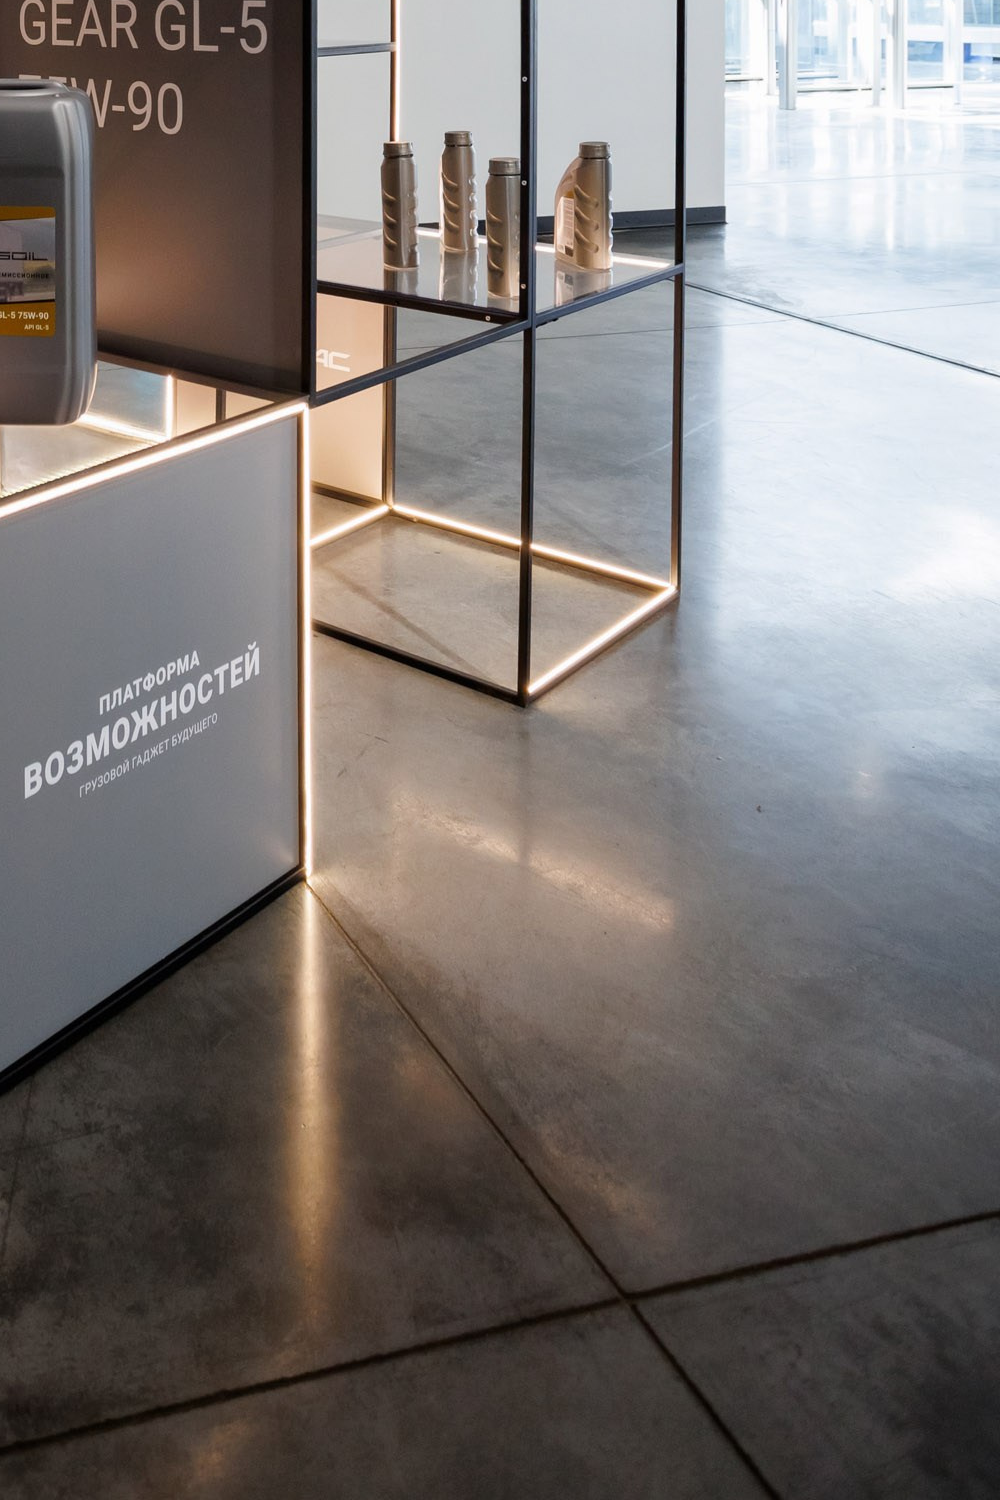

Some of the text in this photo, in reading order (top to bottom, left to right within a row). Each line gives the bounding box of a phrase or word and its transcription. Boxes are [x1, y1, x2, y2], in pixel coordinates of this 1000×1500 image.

[18, 74, 183, 135] W-90
[18, 312, 49, 320] 75W-90
[99, 650, 200, 715] ПЛАТФОРМА
[23, 641, 260, 799] ВОЗМОЖНОСТЕЙ
[79, 712, 218, 798] ГРУЗОВОЙ ГАДЖЕТ БУДУЩЕГО
